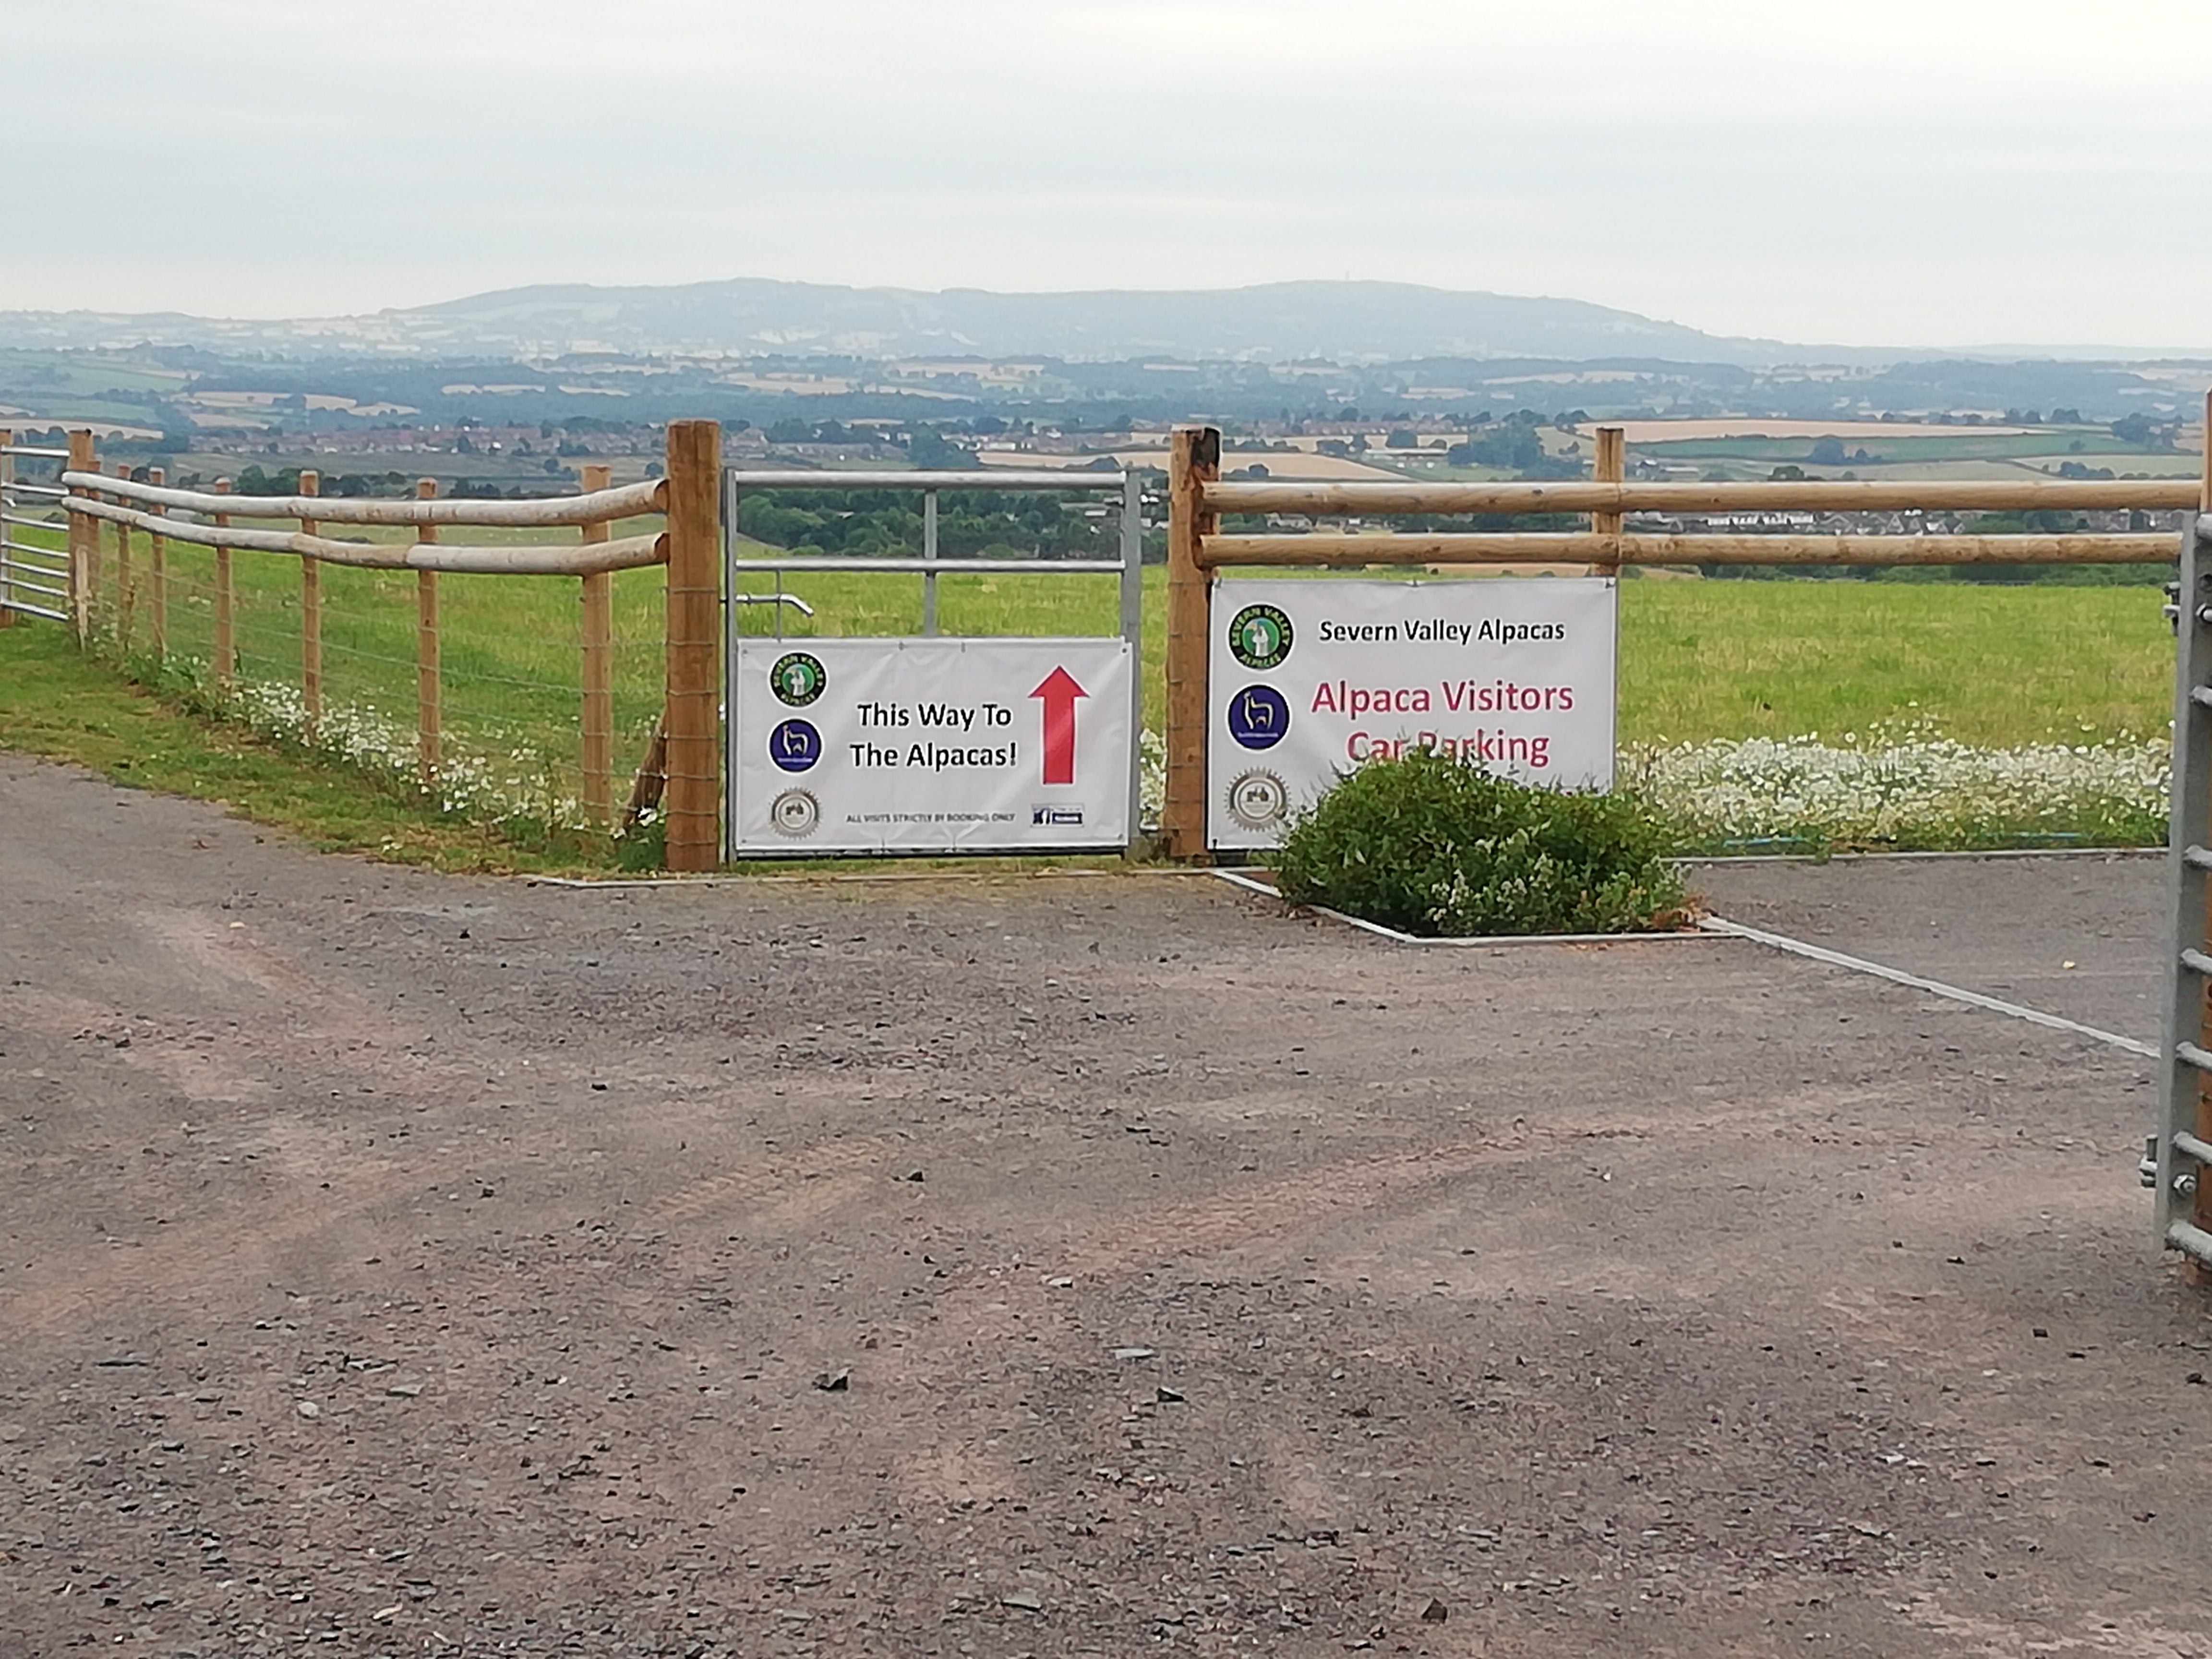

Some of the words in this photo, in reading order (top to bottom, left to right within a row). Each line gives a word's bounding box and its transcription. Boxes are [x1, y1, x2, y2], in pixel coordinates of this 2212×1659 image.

[1319, 621, 1397, 641] Severn
[1404, 619, 1472, 646] Valley
[1478, 618, 1565, 645] Alpacas
[1311, 680, 1430, 721] Alpaca
[1442, 679, 1574, 712] Visitors
[857, 702, 910, 726] This
[918, 704, 975, 732] Way
[982, 704, 1011, 726] To
[849, 742, 898, 767] The
[906, 742, 1016, 772] Alpacas!
[1347, 732, 1409, 761] Car
[846, 814, 862, 823] ALL
[947, 813, 990, 822] BOOKING
[991, 813, 1016, 822] ONLY
